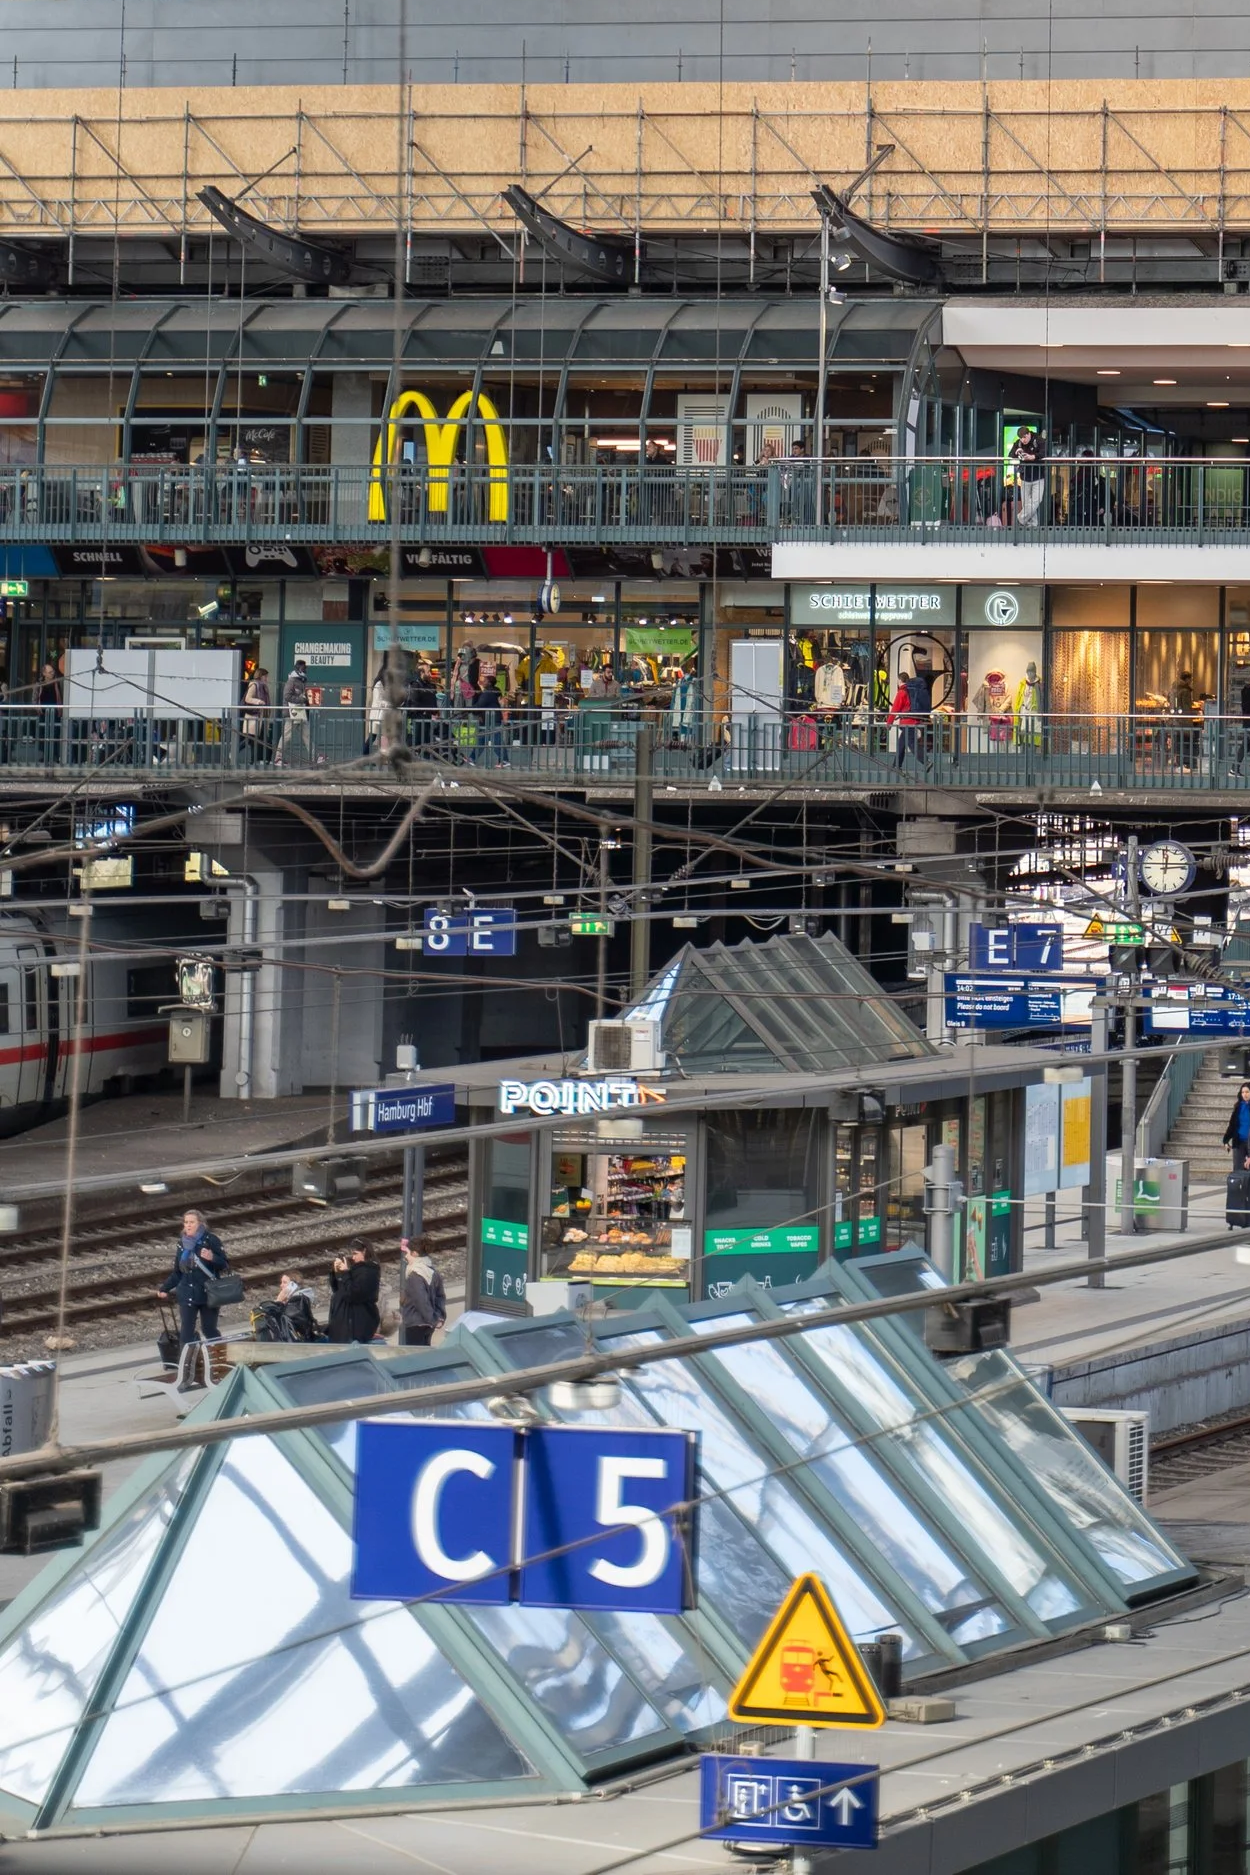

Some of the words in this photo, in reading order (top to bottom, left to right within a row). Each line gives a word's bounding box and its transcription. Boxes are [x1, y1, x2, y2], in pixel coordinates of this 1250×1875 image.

[72, 551, 123, 563] SCHNELL
[405, 551, 473, 566] VIFÄLTIG
[294, 642, 352, 655] CHANGEMAKING
[309, 655, 336, 667] BEAUTY
[428, 915, 449, 951] 8
[473, 915, 494, 950] E
[988, 929, 1009, 965] E
[1037, 929, 1057, 964] 7
[501, 1080, 636, 1115] POINT
[378, 1101, 416, 1123] Hamburg
[416, 1098, 433, 1118] Hbf
[410, 1449, 497, 1583] C
[588, 1456, 670, 1589] 5
